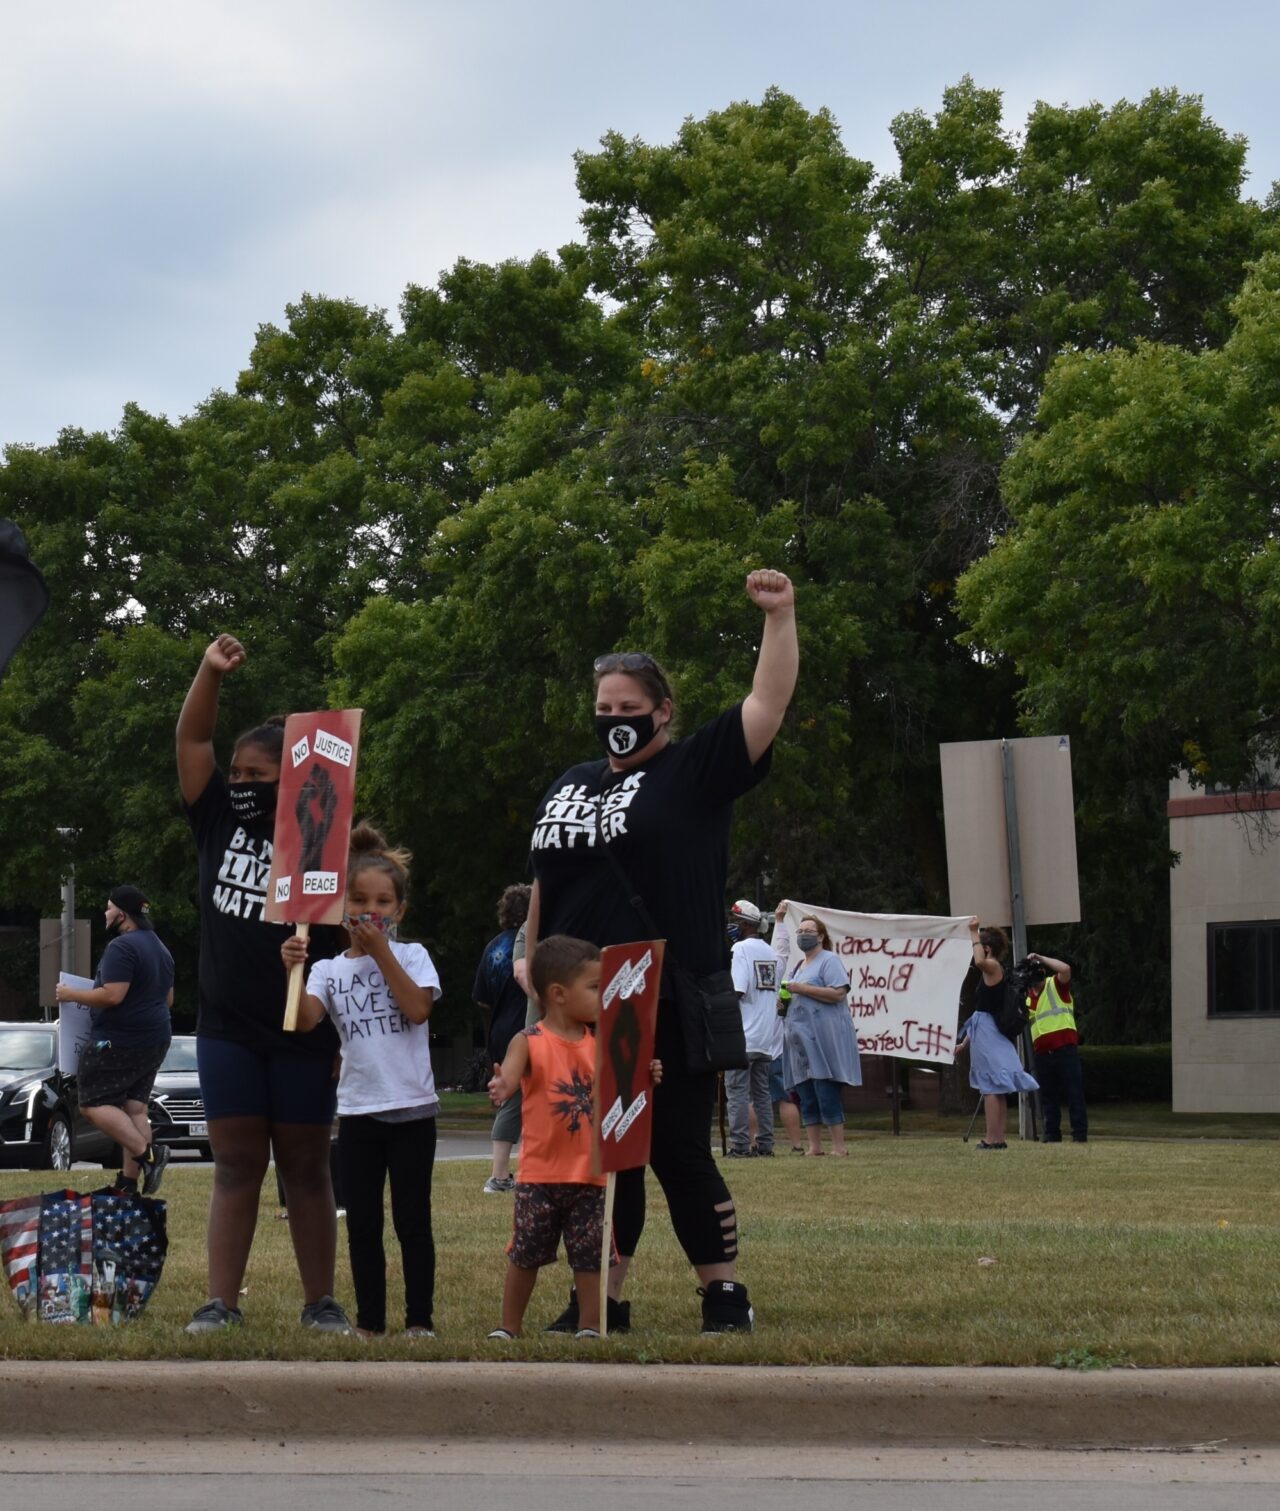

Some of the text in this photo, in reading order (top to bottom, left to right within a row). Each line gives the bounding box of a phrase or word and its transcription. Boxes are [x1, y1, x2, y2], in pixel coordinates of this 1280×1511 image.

[293, 736, 350, 763] NO JUSTICE
[229, 826, 274, 860] BLA
[531, 811, 628, 852] MATTER
[225, 854, 272, 888] LIV
[277, 878, 336, 898] NO PEACE
[213, 884, 278, 923] MATT
[326, 971, 388, 997] BLAC
